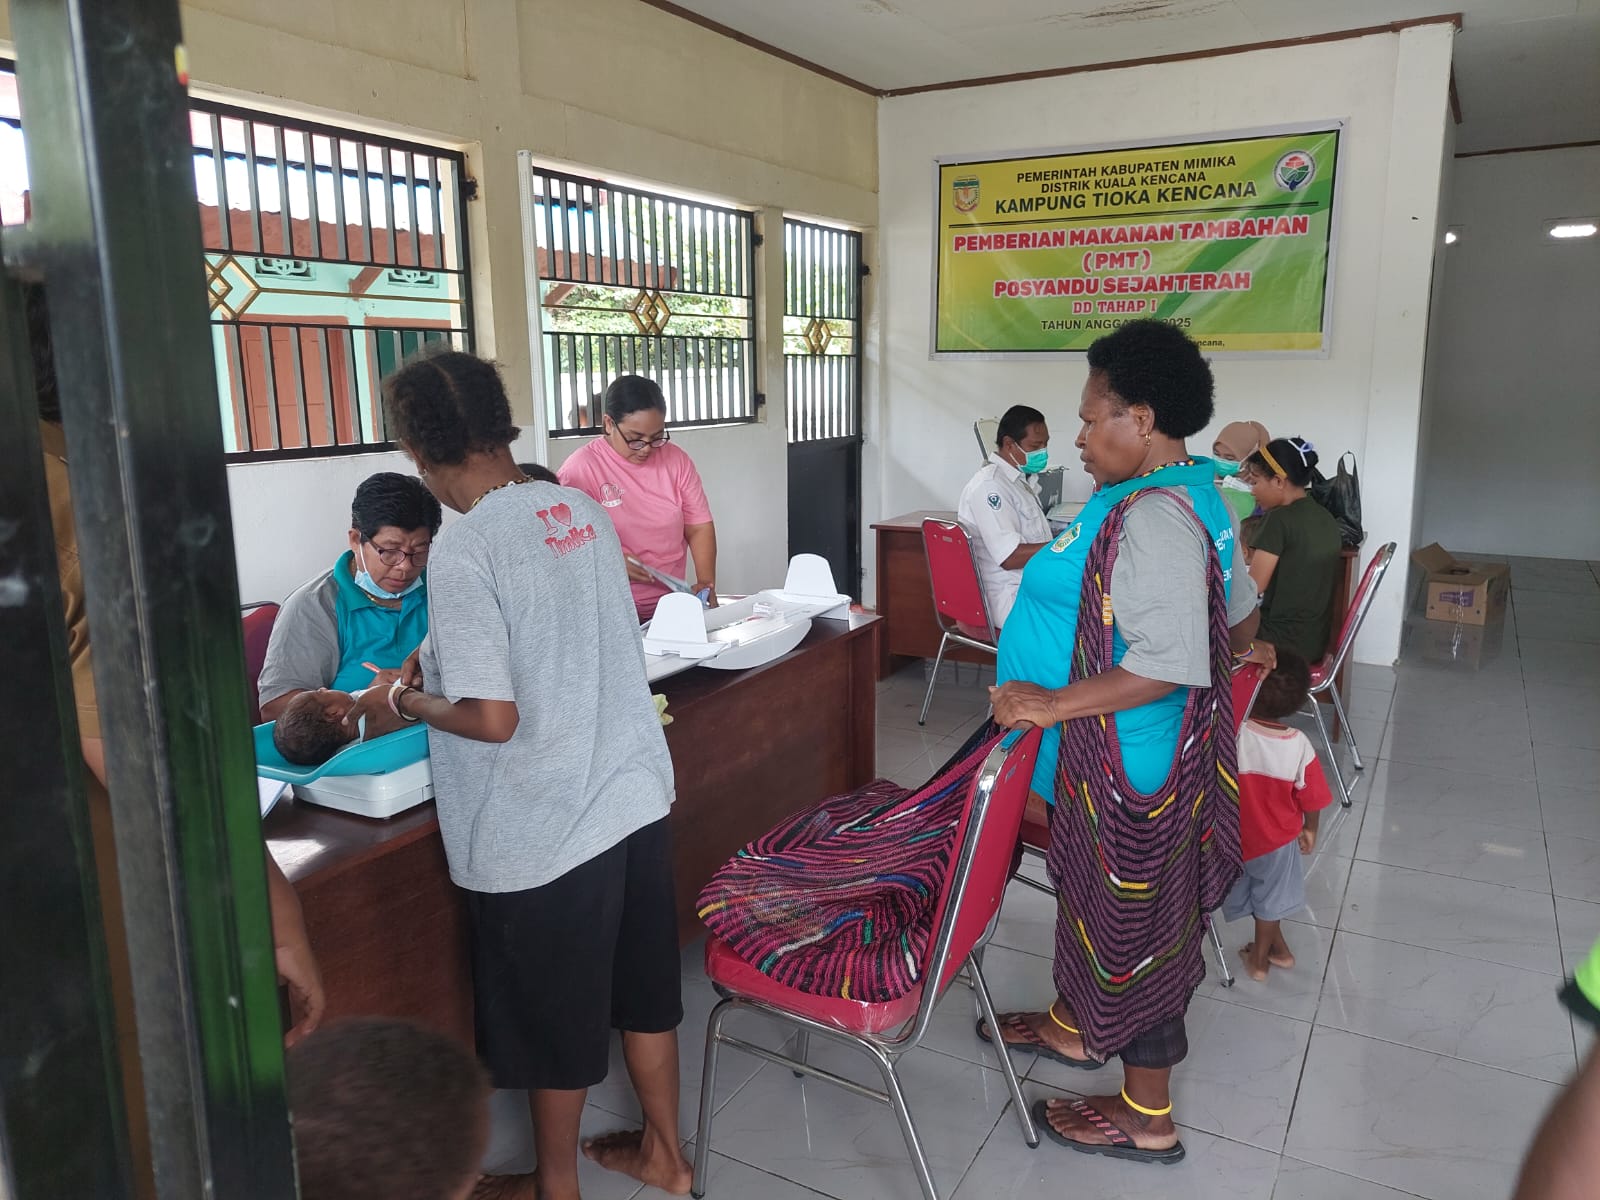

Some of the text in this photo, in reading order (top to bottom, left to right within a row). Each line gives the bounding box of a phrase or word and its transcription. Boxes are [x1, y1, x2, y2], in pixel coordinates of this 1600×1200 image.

[1017, 155, 1236, 183] PEMERINTAH KABUPATEN MIMIKA
[1041, 171, 1206, 193] DISTRIK KUALA KENCANA
[995, 182, 1257, 214] KAMPUNG TIOKA KENCANA
[954, 216, 1309, 252] PEMBERIAN MAKANAN TAMBAHAN
[994, 272, 1251, 297] POSYANDU SEJAHTERAH
[1072, 299, 1157, 313] DD TAHAP I
[1041, 319, 1081, 330] TAHUN
[536, 509, 558, 536] I
